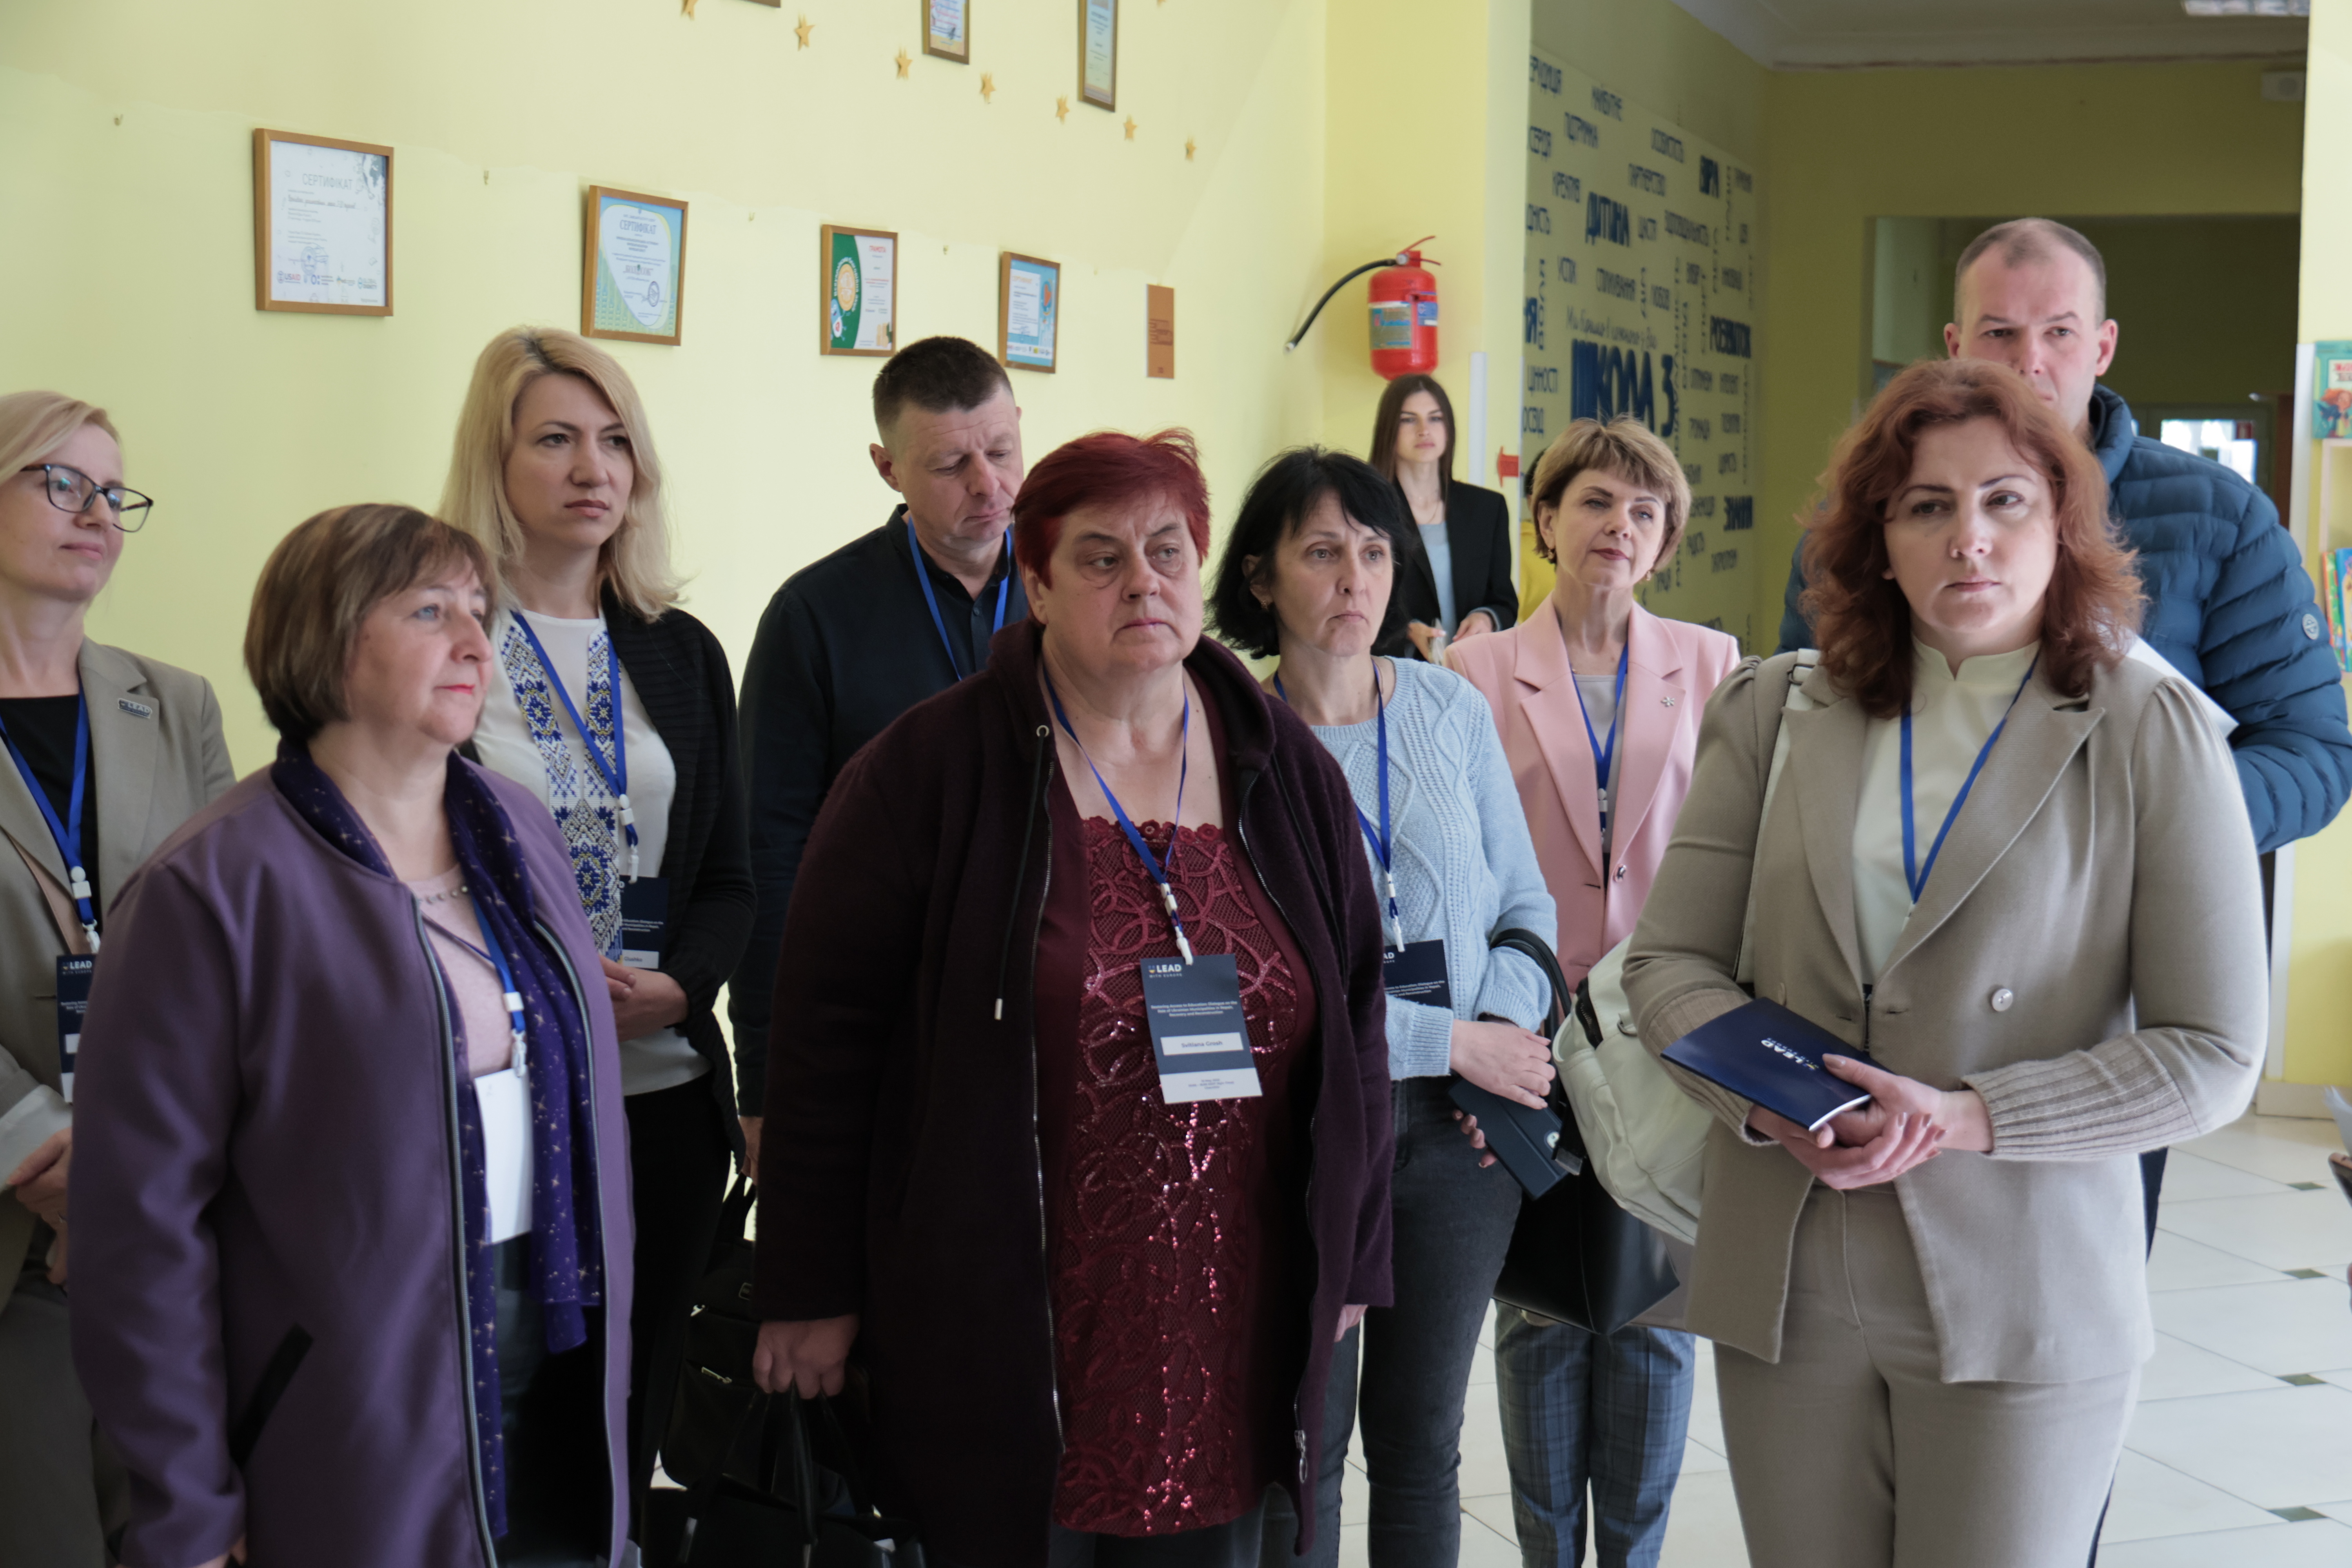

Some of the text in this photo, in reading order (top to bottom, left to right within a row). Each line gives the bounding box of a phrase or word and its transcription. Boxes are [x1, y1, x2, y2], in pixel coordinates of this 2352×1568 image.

[303, 174, 352, 190] СЕРТИФІКАТ
[620, 220, 656, 234] СЕРТИФІКАТ
[1572, 339, 1654, 433] ШКОЛА
[128, 702, 150, 713] LEAD
[70, 960, 92, 969] LEAD
[1156, 964, 1182, 973] LEAD
[1761, 1040, 1803, 1064] LEAD
[1767, 1038, 1798, 1055] EUROPE
